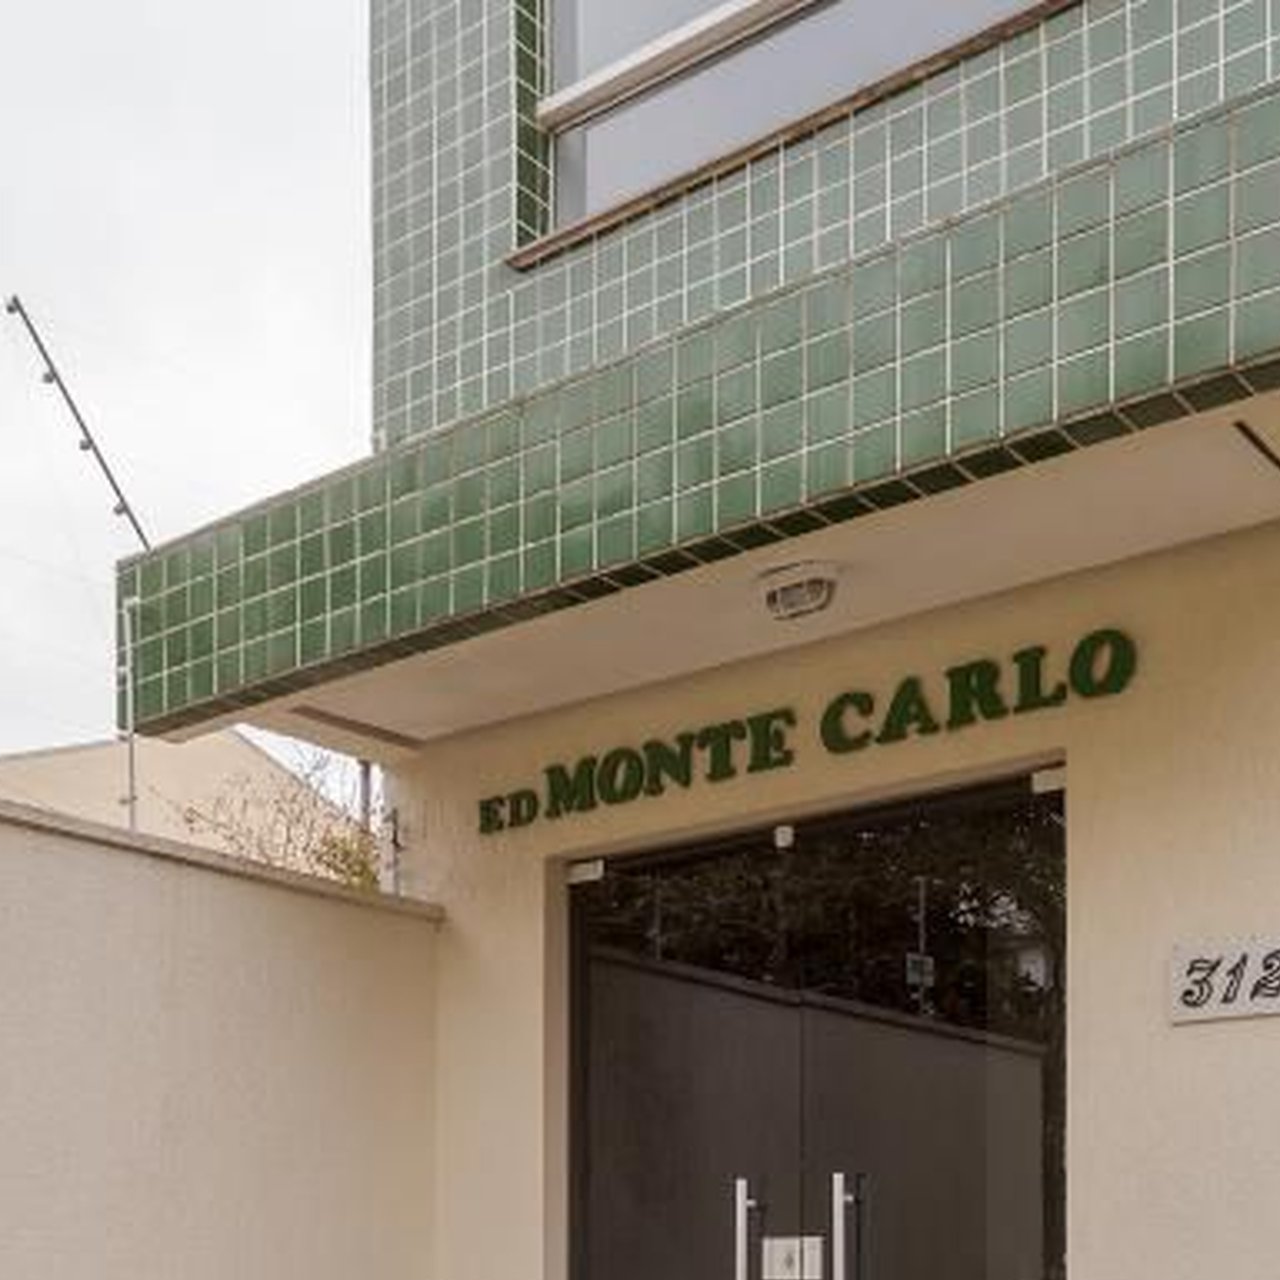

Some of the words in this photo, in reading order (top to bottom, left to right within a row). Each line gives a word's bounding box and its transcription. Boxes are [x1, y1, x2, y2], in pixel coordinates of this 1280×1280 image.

[477, 789, 539, 835] ED
[544, 707, 797, 820] MONTE
[819, 628, 1138, 755] CARLO
